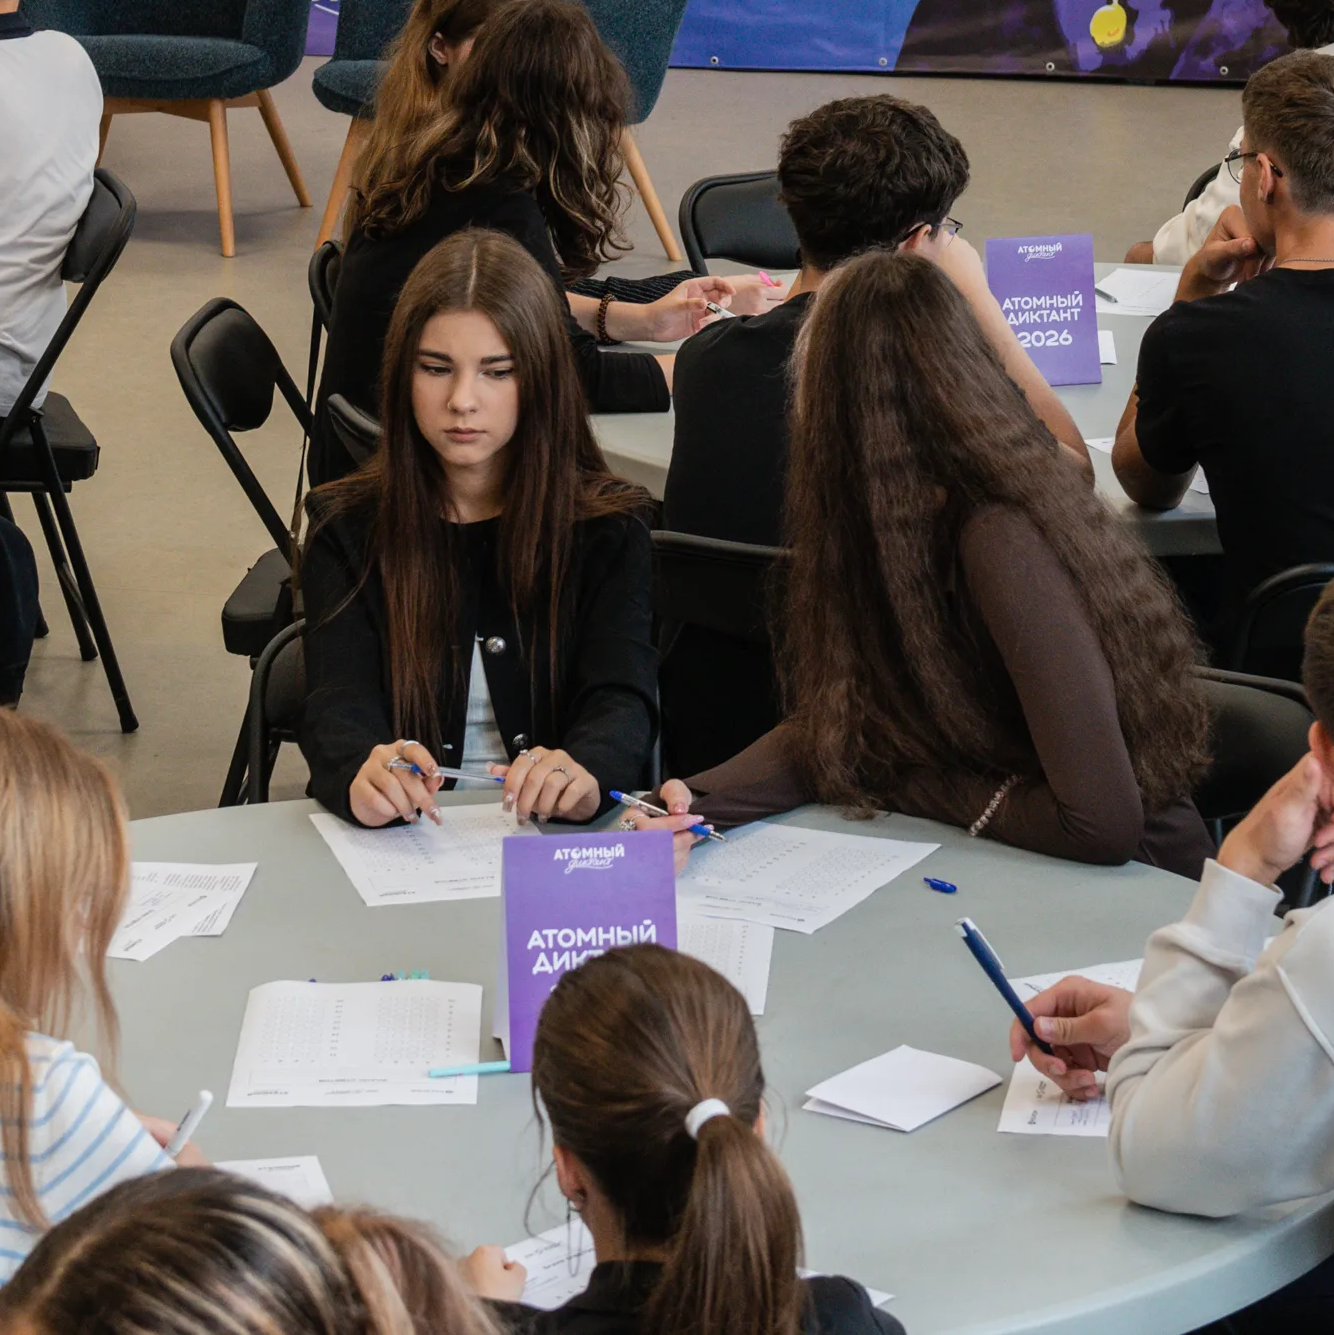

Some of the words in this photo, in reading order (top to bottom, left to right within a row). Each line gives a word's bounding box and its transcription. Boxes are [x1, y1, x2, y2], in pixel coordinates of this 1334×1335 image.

[1017, 242, 1063, 254] АТОМНЫЙ
[1002, 290, 1083, 311] АТОМНЫЙ
[1006, 308, 1081, 326] ДИКТАНТ
[1017, 329, 1073, 348] 2026
[553, 843, 626, 861] АТОМНЫЙ
[526, 918, 657, 950] АТОМНЫЙ
